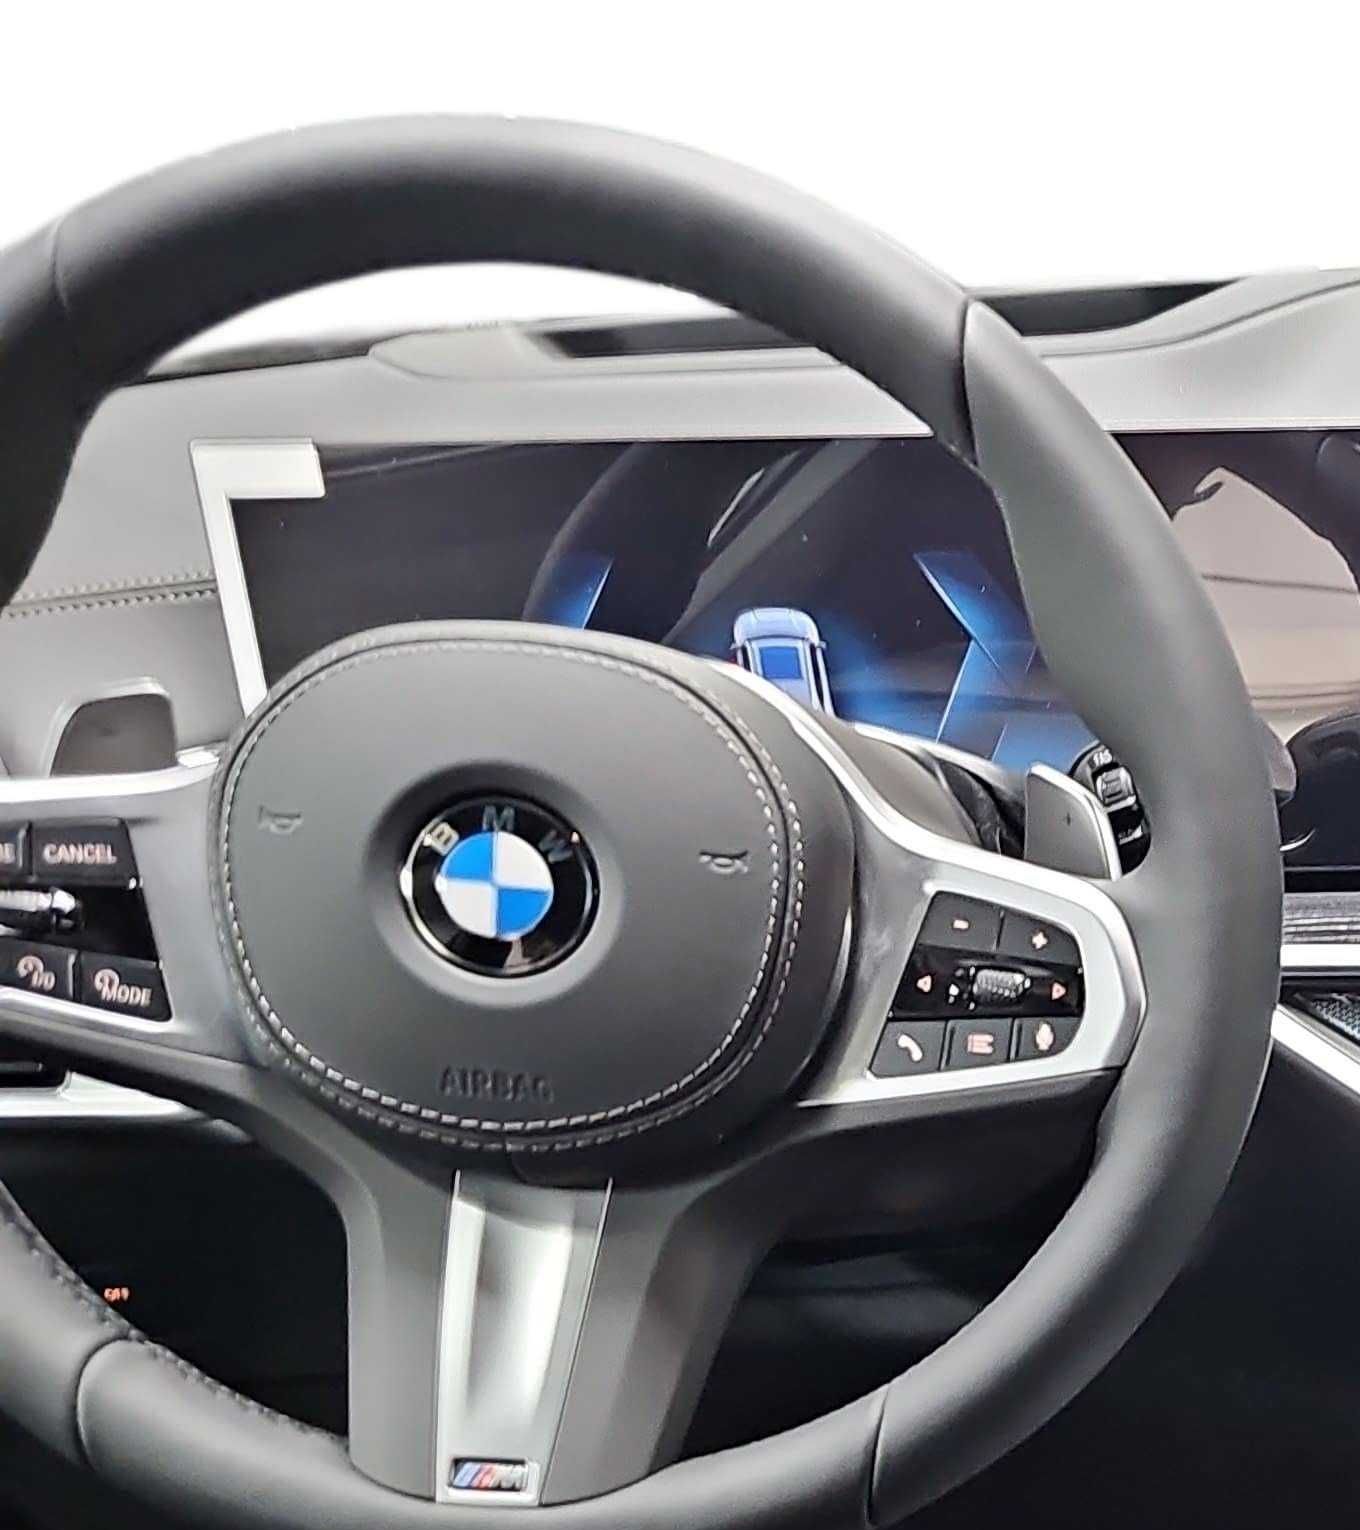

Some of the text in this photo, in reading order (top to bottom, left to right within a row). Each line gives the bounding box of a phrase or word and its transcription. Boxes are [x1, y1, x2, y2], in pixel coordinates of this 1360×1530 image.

[427, 804, 574, 864] BMW
[43, 843, 118, 864] CANCEL
[101, 982, 152, 1007] MODE
[440, 1066, 554, 1104] AIRBAG
